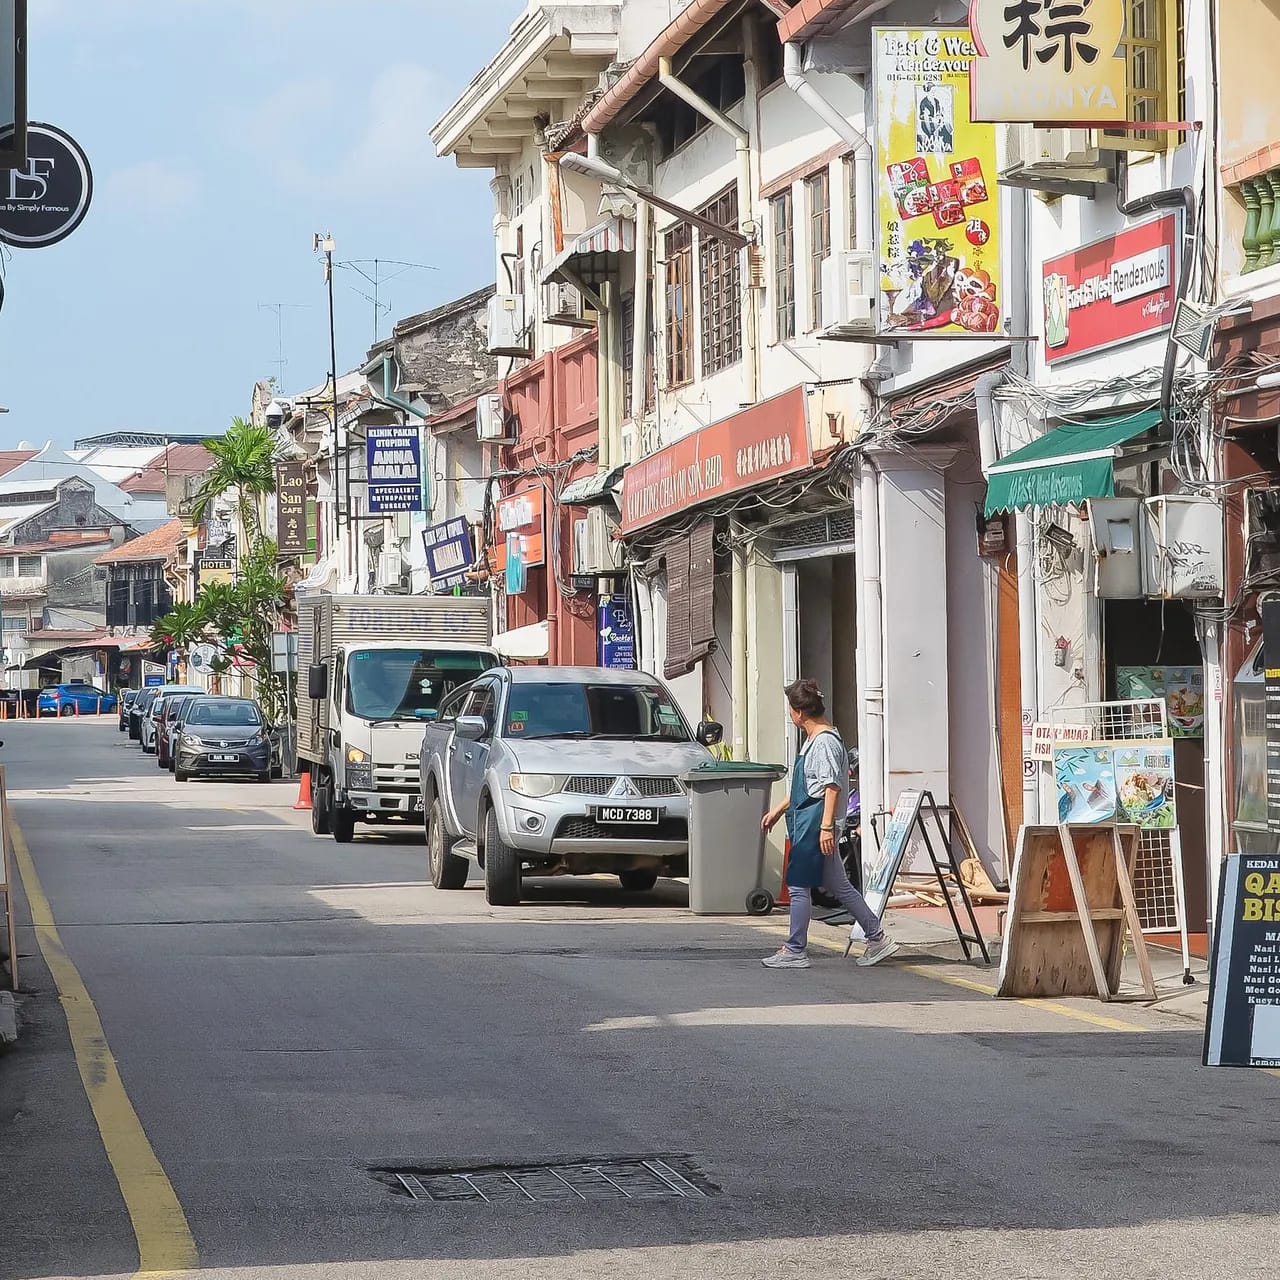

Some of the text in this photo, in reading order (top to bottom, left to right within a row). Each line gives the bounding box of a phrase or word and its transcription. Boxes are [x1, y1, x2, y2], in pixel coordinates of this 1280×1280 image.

[885, 36, 977, 56] East & Wes
[896, 57, 969, 72] Rendezvou
[7, 204, 15, 212] By
[17, 204, 40, 212] Simply
[41, 204, 69, 212] Famous
[1113, 258, 1165, 295] Rendezvous
[368, 429, 392, 437] KLINIK
[373, 450, 414, 465] ANNA
[371, 465, 418, 479] MALAI
[280, 473, 303, 487] Lao
[280, 492, 302, 504] San
[201, 561, 229, 569] HOTEL
[1035, 743, 1051, 755] FISH
[602, 807, 652, 821] MCD 7388
[1246, 860, 1279, 869] KEDAI
[1254, 945, 1276, 953] Nasi
[1249, 955, 1271, 963] Nasi
[1249, 965, 1272, 973] Nasi
[1243, 975, 1265, 984] Nasi
[1245, 986, 1265, 994] Mee
[1249, 1059, 1280, 1067] Lemon
